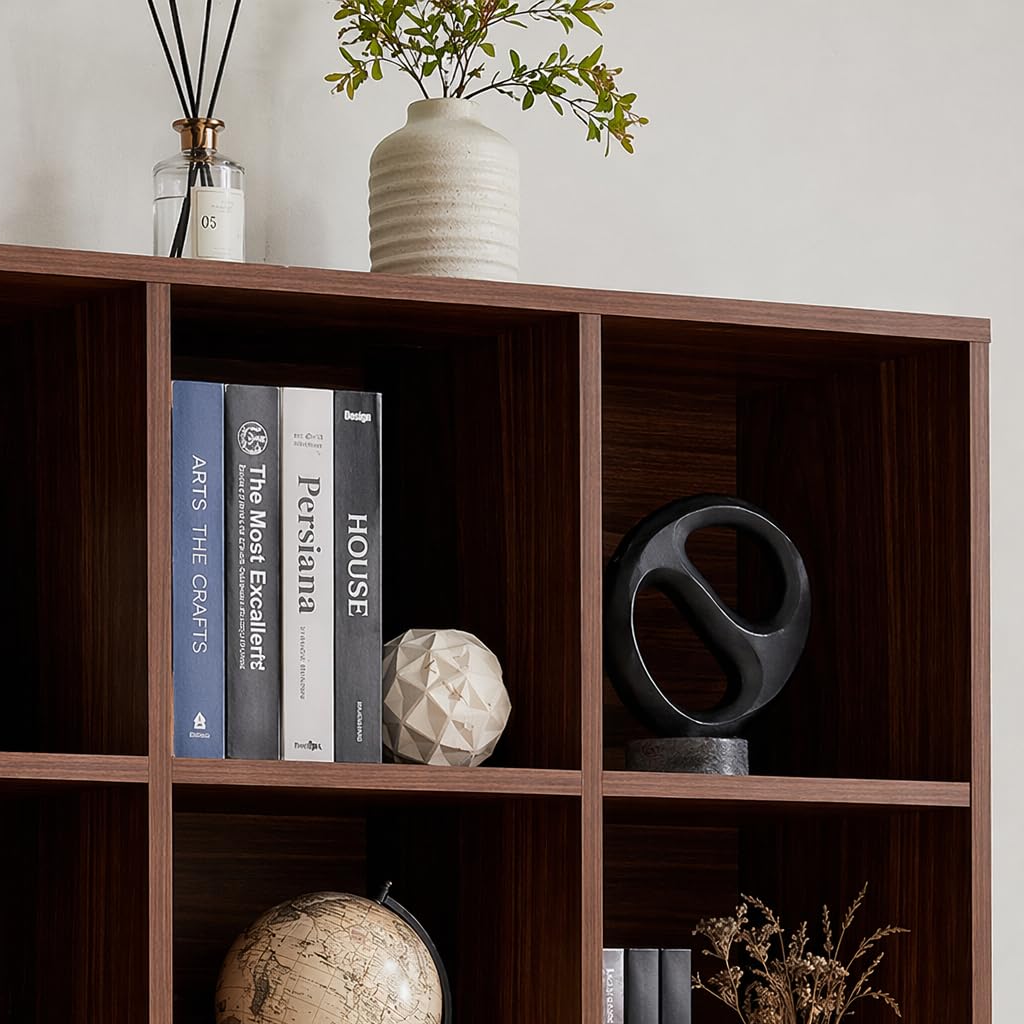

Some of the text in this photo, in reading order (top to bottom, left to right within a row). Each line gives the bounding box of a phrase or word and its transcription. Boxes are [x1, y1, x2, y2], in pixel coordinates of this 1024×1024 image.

[201, 215, 217, 229] 05
[249, 464, 267, 505] The
[191, 454, 208, 654] ARTS THE CRAFTS
[249, 510, 267, 563] Most
[297, 475, 322, 614] Persiana
[347, 513, 369, 617] HOUSE
